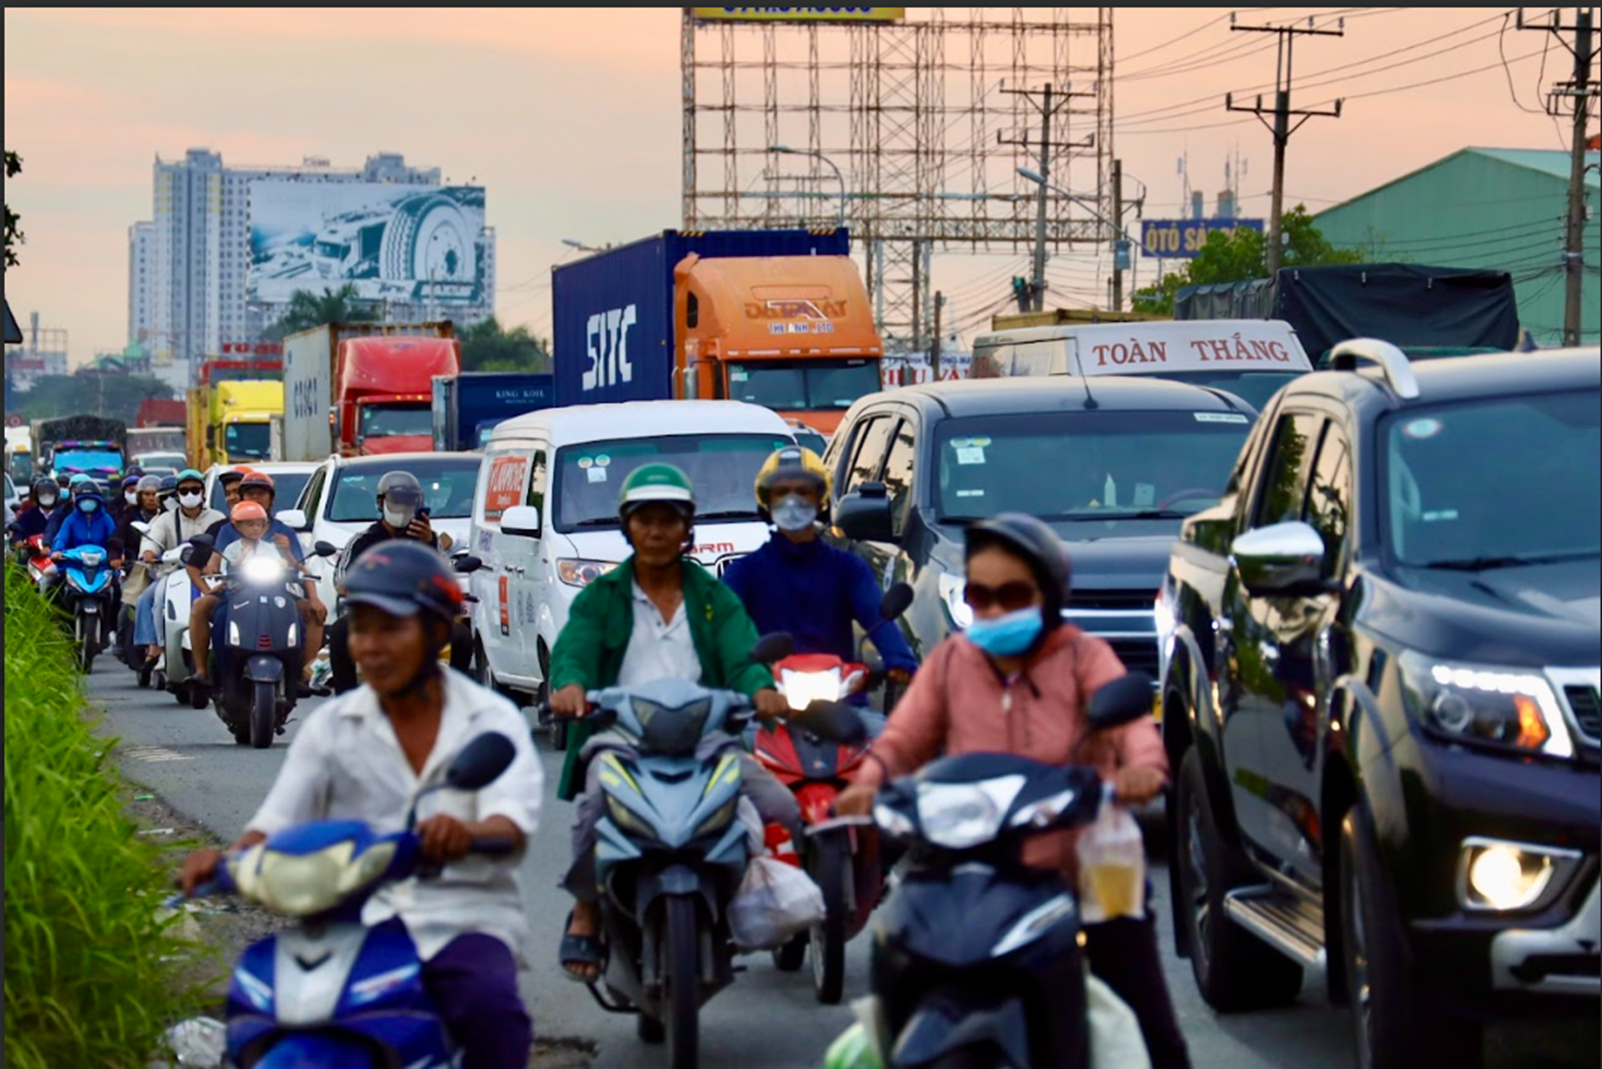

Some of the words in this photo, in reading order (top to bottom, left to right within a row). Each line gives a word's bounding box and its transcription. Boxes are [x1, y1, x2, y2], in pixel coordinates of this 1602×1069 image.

[583, 304, 637, 391] SITC
[1093, 338, 1167, 366] TOÀN
[1191, 332, 1290, 362] THẮNG
[495, 390, 519, 399] KING
